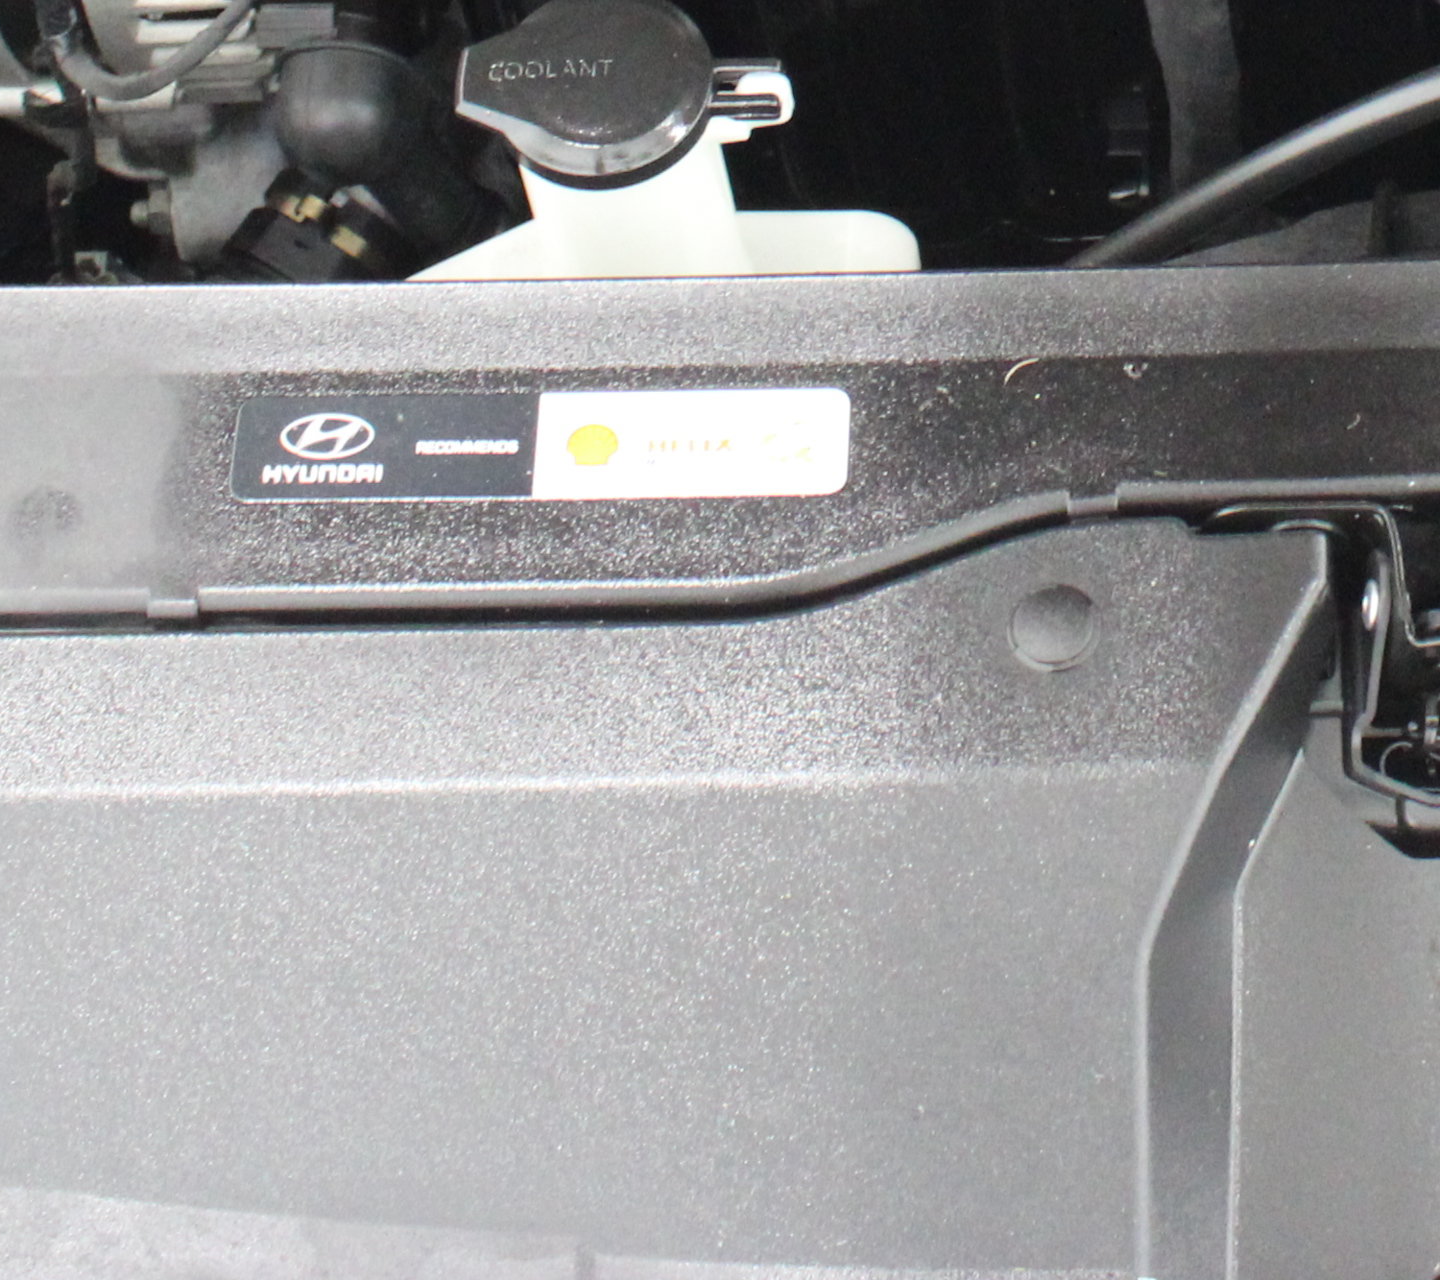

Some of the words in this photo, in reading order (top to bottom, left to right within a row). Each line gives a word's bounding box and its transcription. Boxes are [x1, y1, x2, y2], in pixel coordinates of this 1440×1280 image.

[487, 58, 614, 83] COOLANT
[261, 462, 384, 486] HYUNDAI
[414, 438, 520, 457] RECOMMENDS
